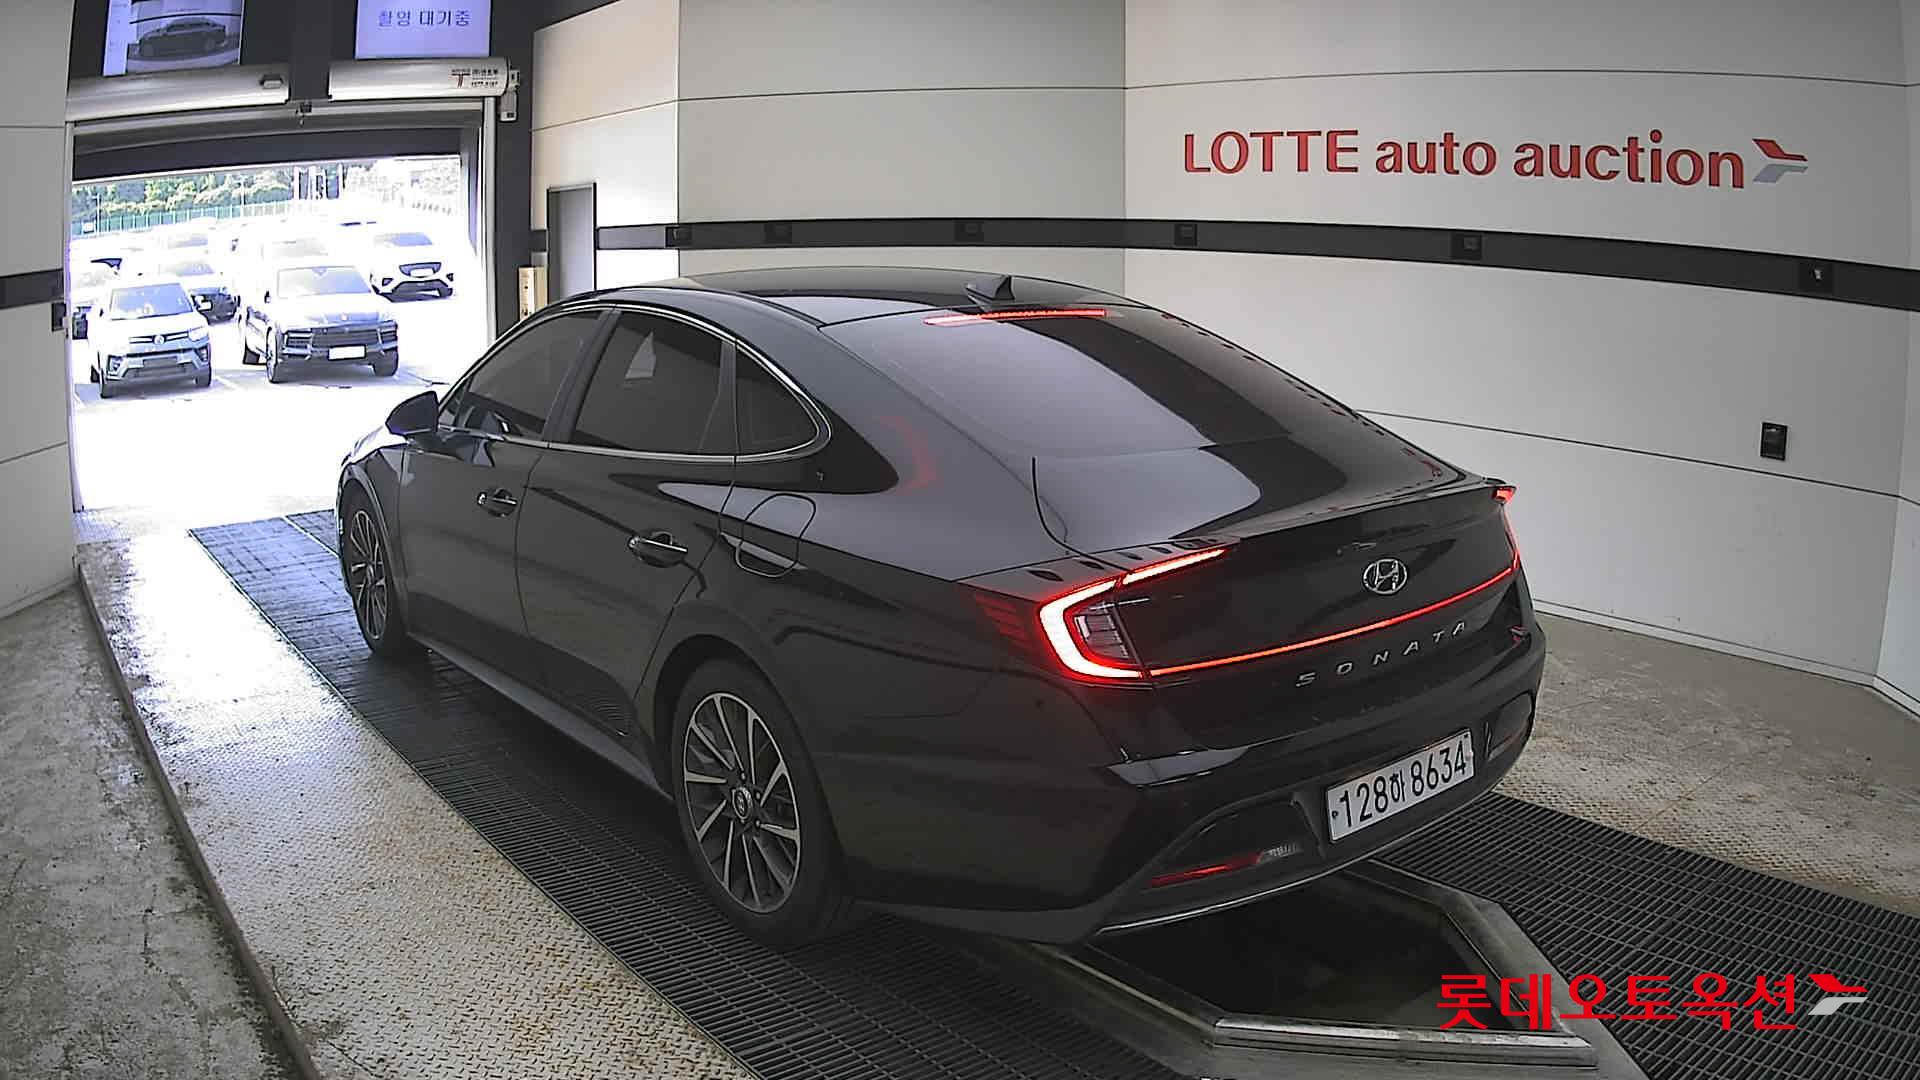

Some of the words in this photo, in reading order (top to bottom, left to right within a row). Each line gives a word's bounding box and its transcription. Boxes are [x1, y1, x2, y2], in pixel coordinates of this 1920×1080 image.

[419, 9, 471, 27] 대기중
[1184, 130, 1358, 175] LOTTE
[1375, 132, 1497, 176] auto
[1513, 129, 1744, 189] auction
[1296, 621, 1466, 687] SONATA
